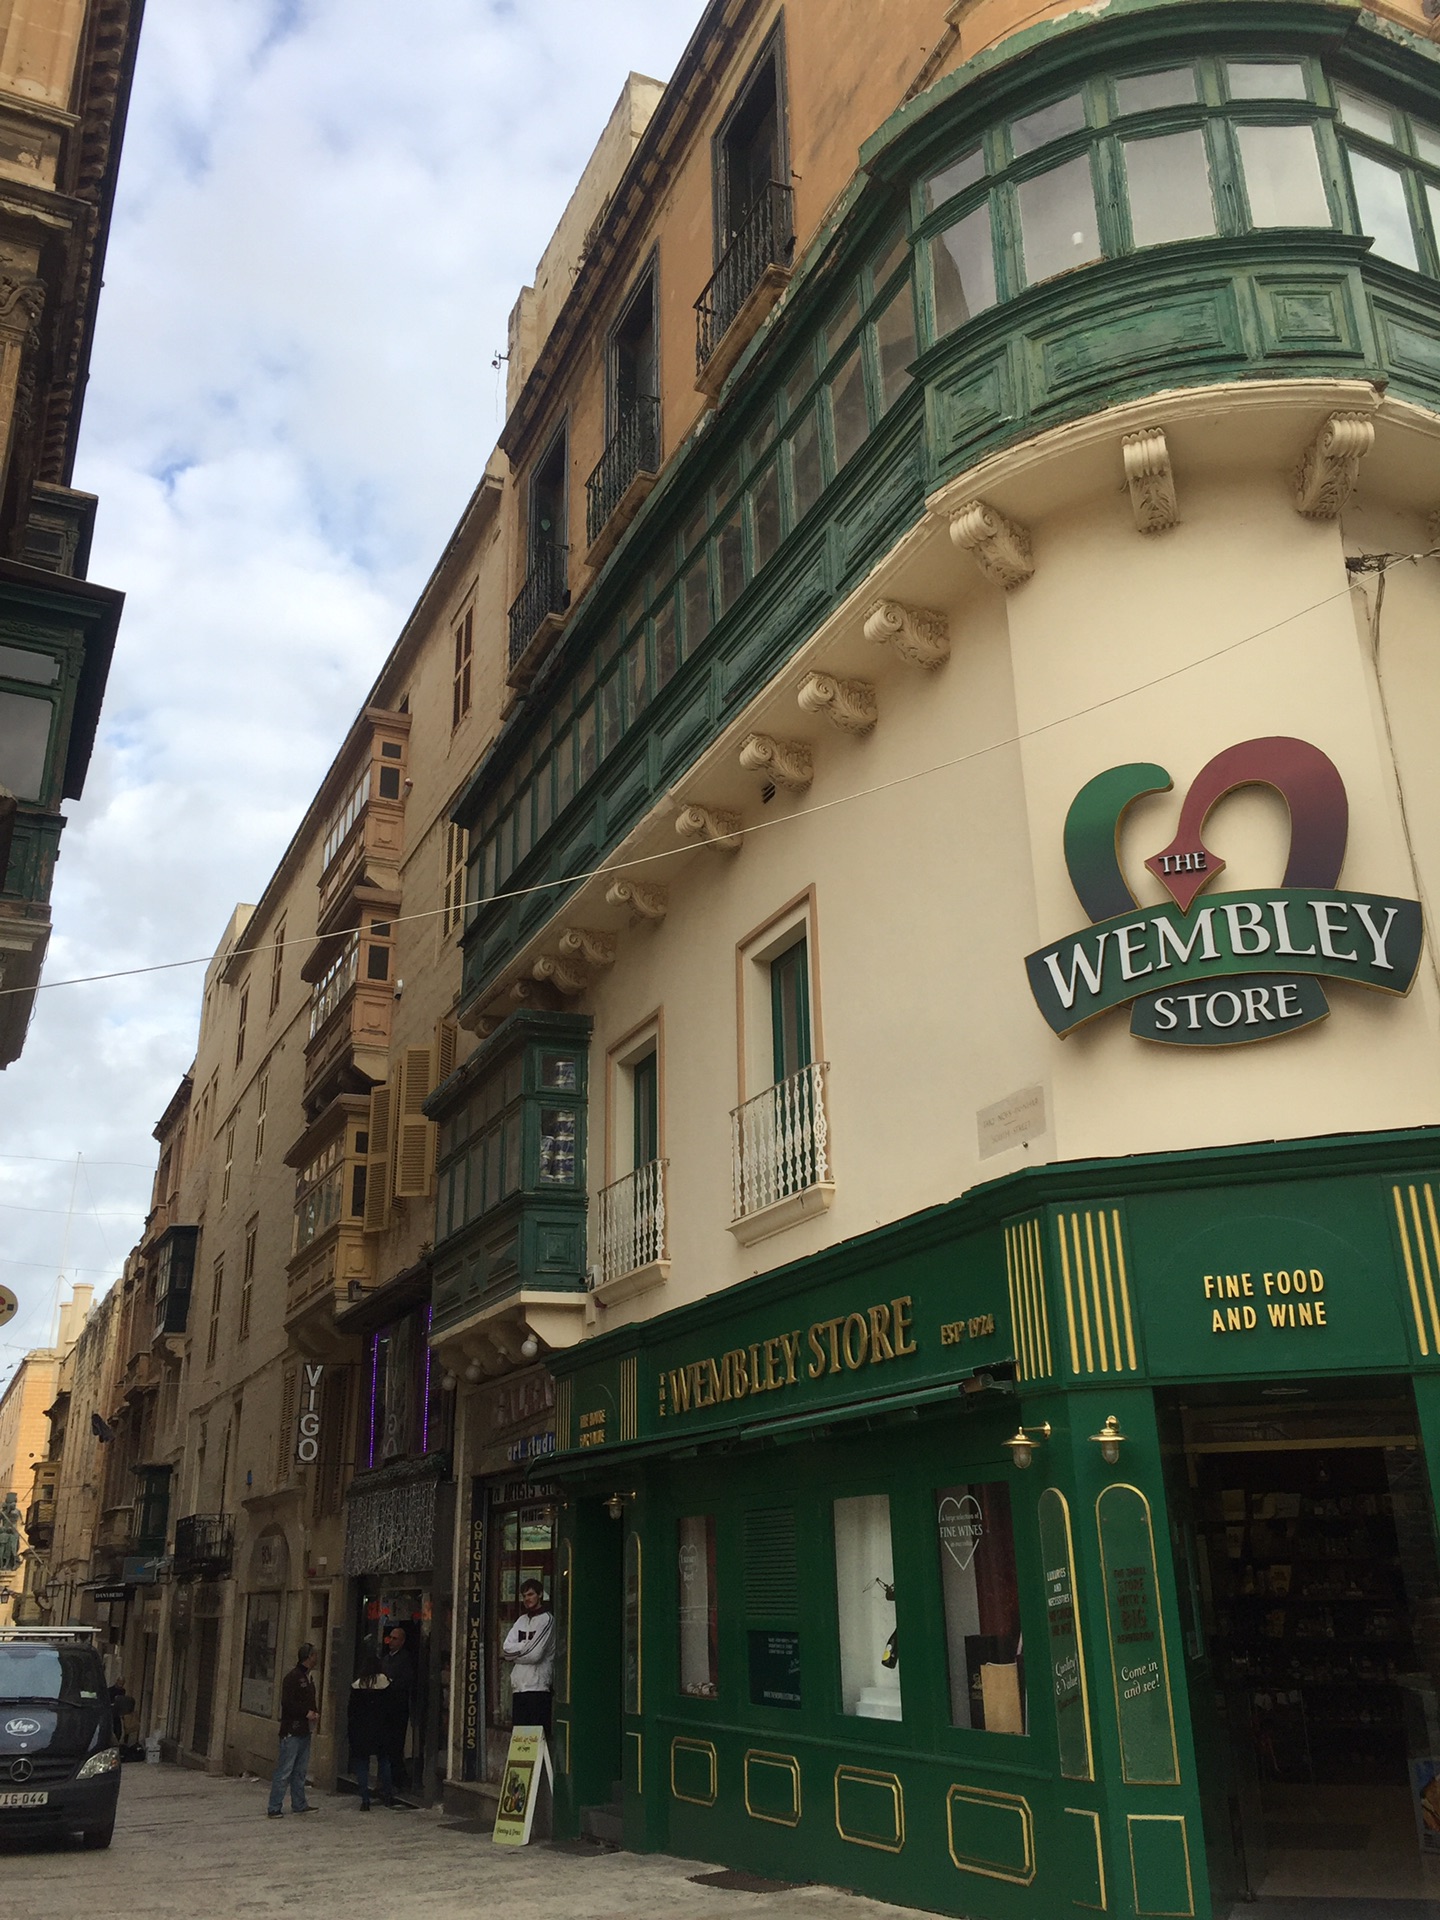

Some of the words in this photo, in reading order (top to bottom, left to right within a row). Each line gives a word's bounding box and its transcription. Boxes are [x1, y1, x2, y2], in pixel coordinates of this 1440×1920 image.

[1158, 851, 1207, 875] THE
[1042, 899, 1400, 1010] WEMBLEY
[1153, 983, 1305, 1031] STORE
[1203, 1272, 1255, 1299] FINE
[1262, 1268, 1325, 1296] FOOD
[1211, 1305, 1257, 1333] AND
[1266, 1300, 1328, 1328] WINE
[669, 1329, 802, 1415] WEMBLEY
[808, 1295, 918, 1380] STORE
[298, 1364, 324, 1462] VIGO
[940, 1526, 957, 1538] FINE
[958, 1524, 983, 1537] WINES
[473, 1519, 483, 1603] ORIGINAL
[1122, 1608, 1147, 1630] BIG
[1056, 1656, 1076, 1677] Quality
[1122, 1666, 1147, 1681] Come
[1149, 1658, 1159, 1672] in
[466, 1617, 480, 1749] WATERCOLOURS
[1061, 1675, 1078, 1691] Value
[1124, 1680, 1141, 1700] and
[1143, 1673, 1160, 1691] see!
[9, 1720, 35, 1733] Vigo
[23, 1793, 46, 1805] 044
